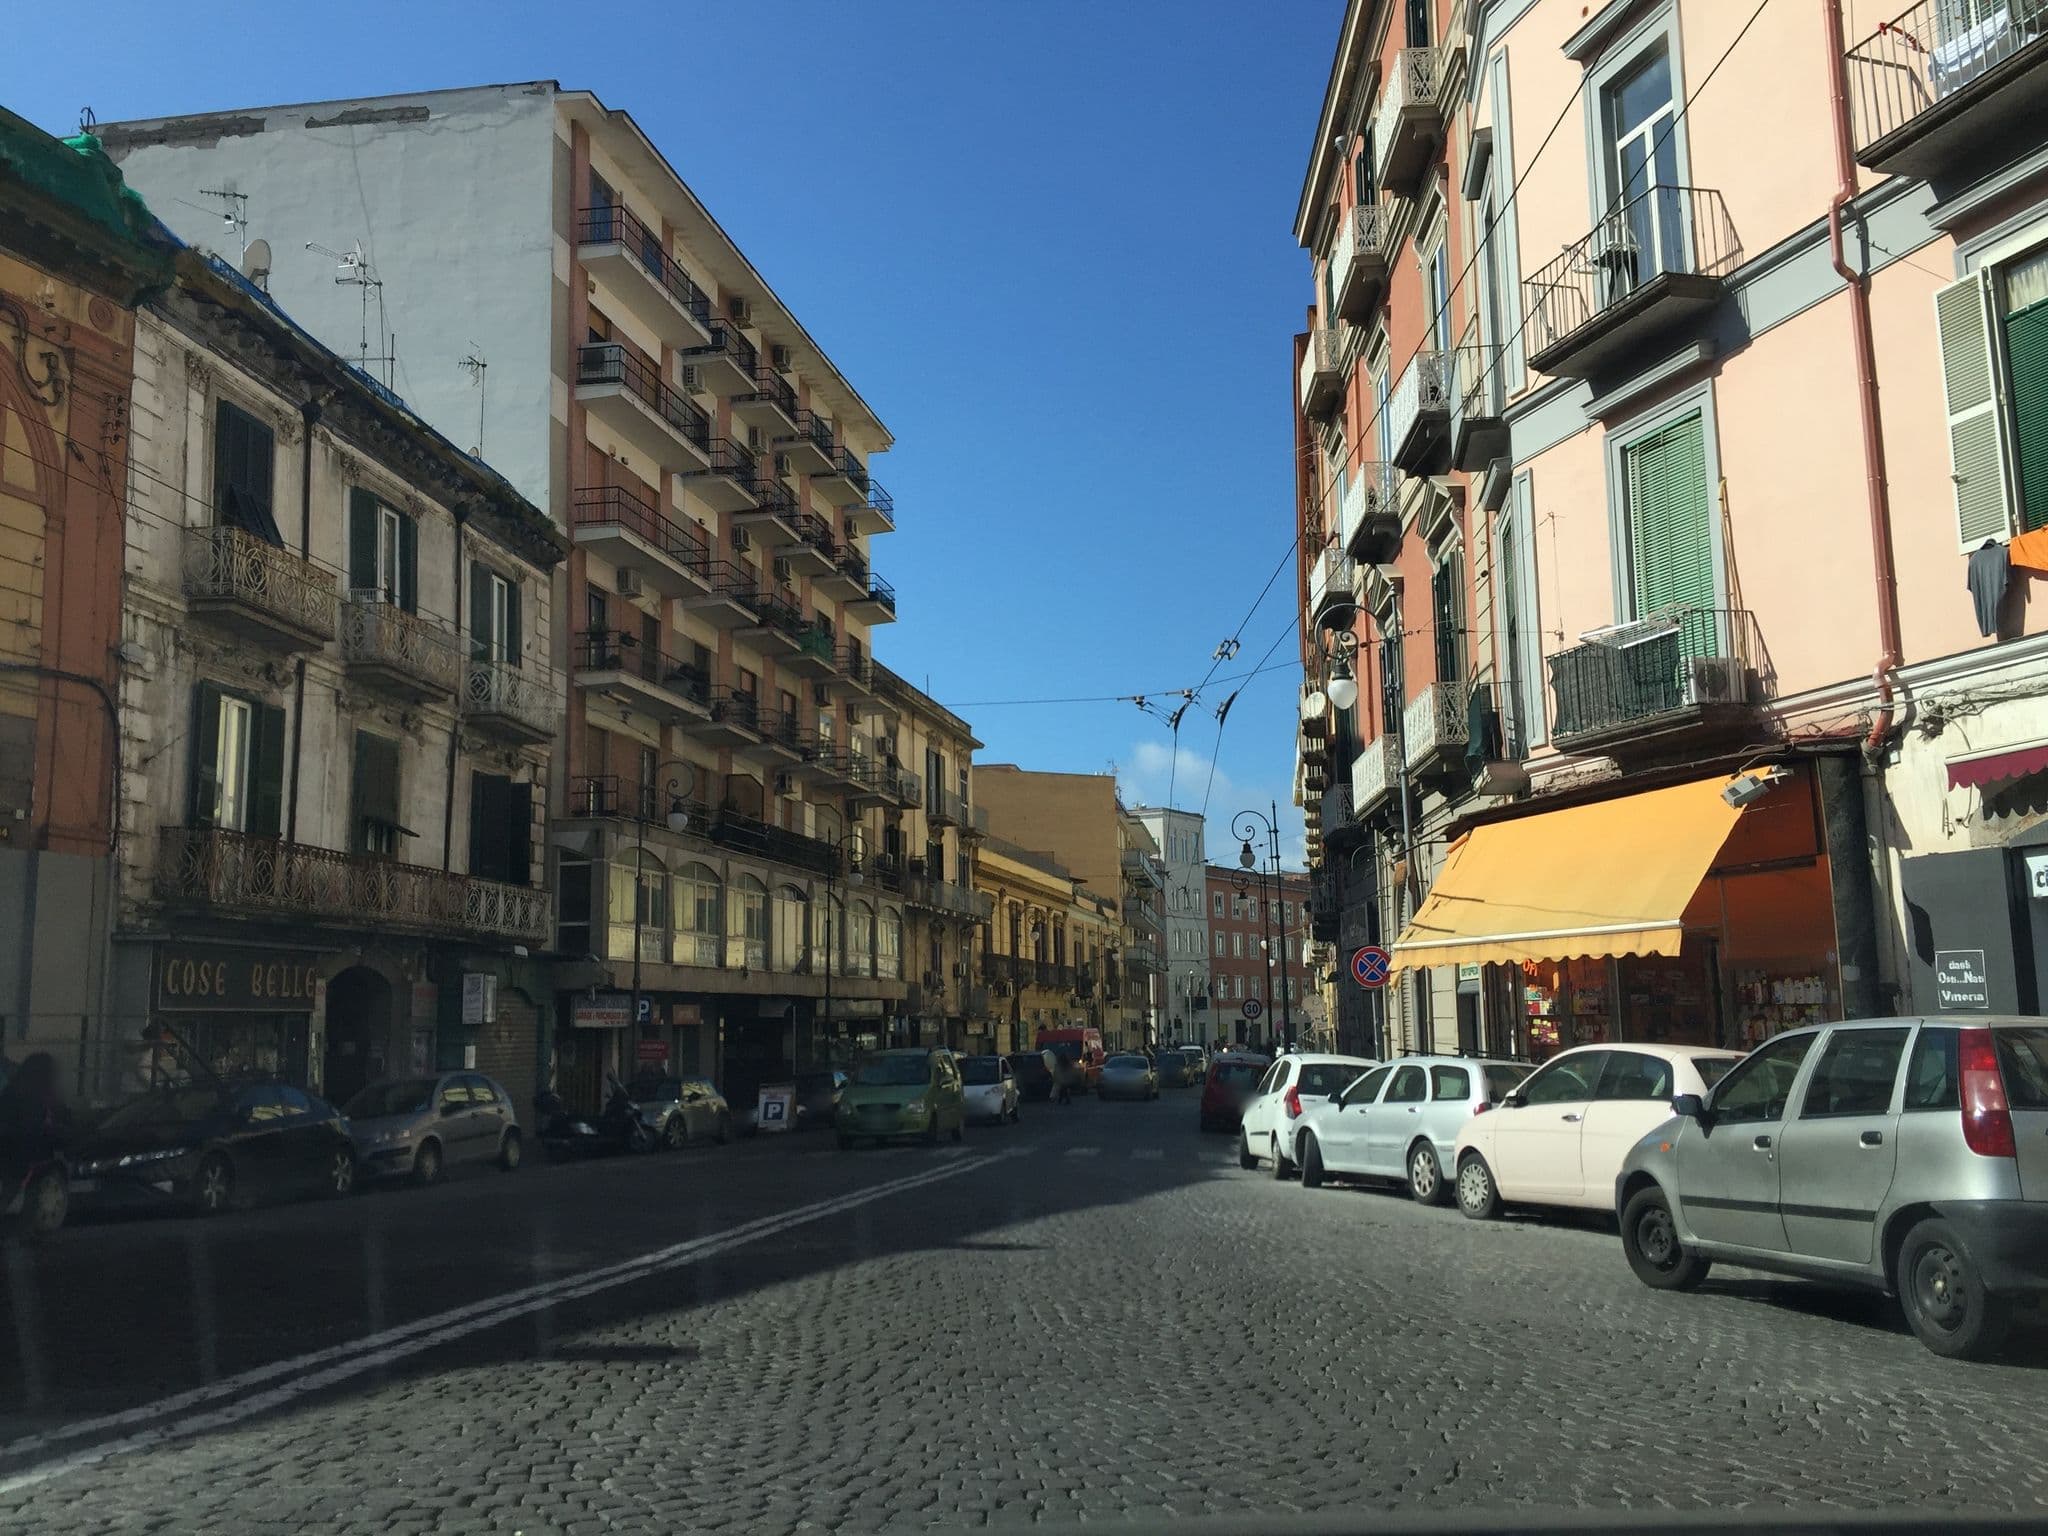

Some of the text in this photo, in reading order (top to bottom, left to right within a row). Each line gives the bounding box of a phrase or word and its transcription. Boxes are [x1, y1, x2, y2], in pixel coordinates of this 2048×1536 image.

[167, 959, 315, 997] COSE BELLE
[1246, 1004, 1258, 1014] 30
[768, 1103, 781, 1118] P
